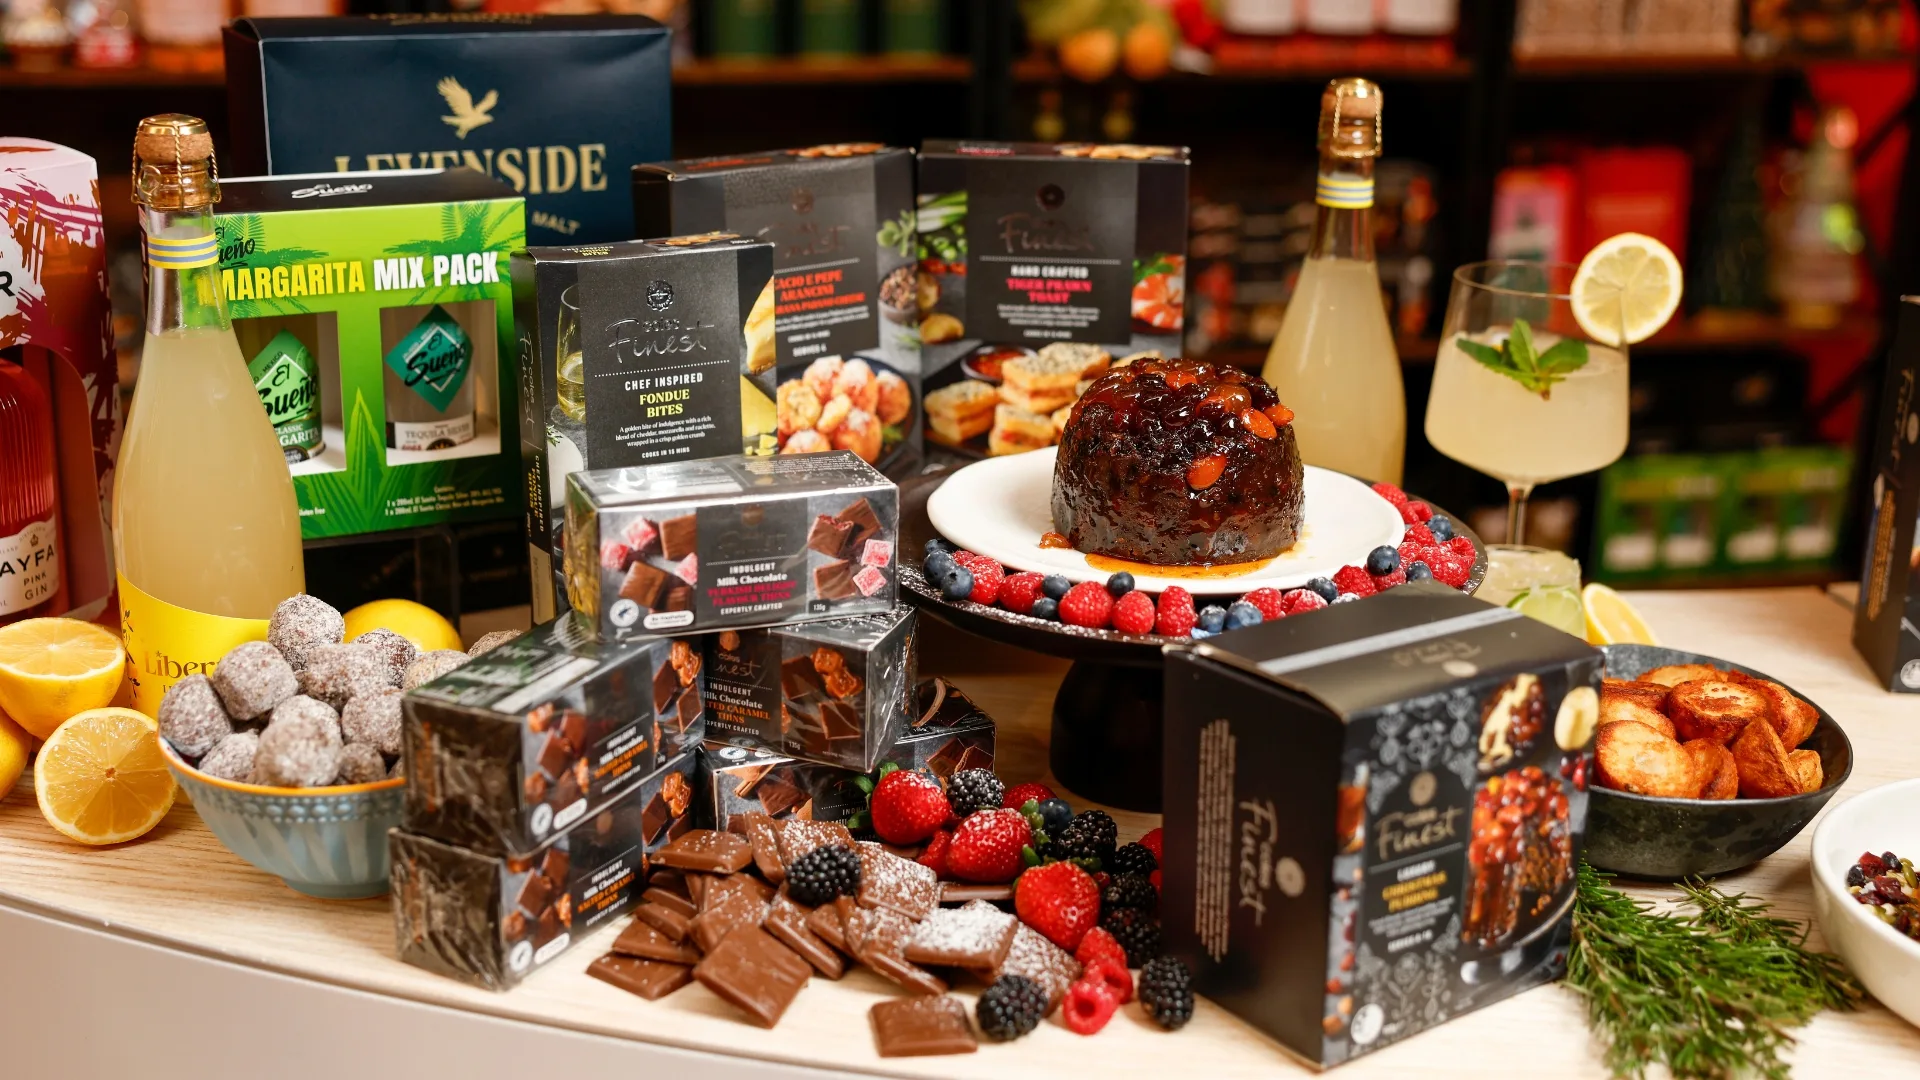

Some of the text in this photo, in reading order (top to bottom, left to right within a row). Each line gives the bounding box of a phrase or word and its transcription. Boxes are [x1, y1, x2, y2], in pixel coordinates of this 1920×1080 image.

[531, 211, 581, 235] MALT
[219, 236, 255, 263] ueño
[222, 251, 500, 301] MARGARITA MIX PACK
[1010, 265, 1089, 279] HAND CRAFTED
[1006, 278, 1092, 293] TIGER PRAWN
[1028, 291, 1070, 304] TOAST
[428, 332, 443, 350] El
[606, 317, 716, 364] Finest
[272, 363, 290, 386] El
[625, 372, 703, 391] CHEF INSPIRED
[639, 389, 690, 405] FONDUE
[646, 403, 684, 418] BITES
[404, 428, 446, 439] TEQUILA
[624, 426, 641, 434] golden
[659, 419, 685, 428] indulgence
[627, 439, 649, 447] wrapped
[659, 436, 672, 444] crisp
[672, 434, 689, 442] golden
[689, 431, 706, 439] crumb
[642, 450, 660, 459] COOKS
[0, 544, 54, 578] AYFA
[729, 562, 776, 574] INDULGENT
[24, 571, 47, 586] PINK
[717, 572, 788, 587] Milk Chocolate
[24, 583, 48, 601] GIN
[707, 580, 797, 598] TURKISH DELIGHT
[761, 591, 791, 602] THINS
[720, 602, 783, 615] EXPERTLY CRAFTED
[145, 650, 217, 679] Liber
[716, 660, 761, 679] nest
[709, 682, 752, 696] INDULGENT
[704, 691, 763, 709] ilk Chocolate
[705, 701, 771, 720] TED CARAMEL
[717, 711, 745, 724] THINS
[733, 725, 760, 735] CRAFTED
[614, 735, 644, 757] Chocolate
[788, 741, 800, 750] 135g
[1374, 805, 1466, 861] Finest
[1239, 797, 1278, 927] Finest
[591, 859, 622, 884] INDULGENT
[583, 866, 631, 900] Milk Chocolate
